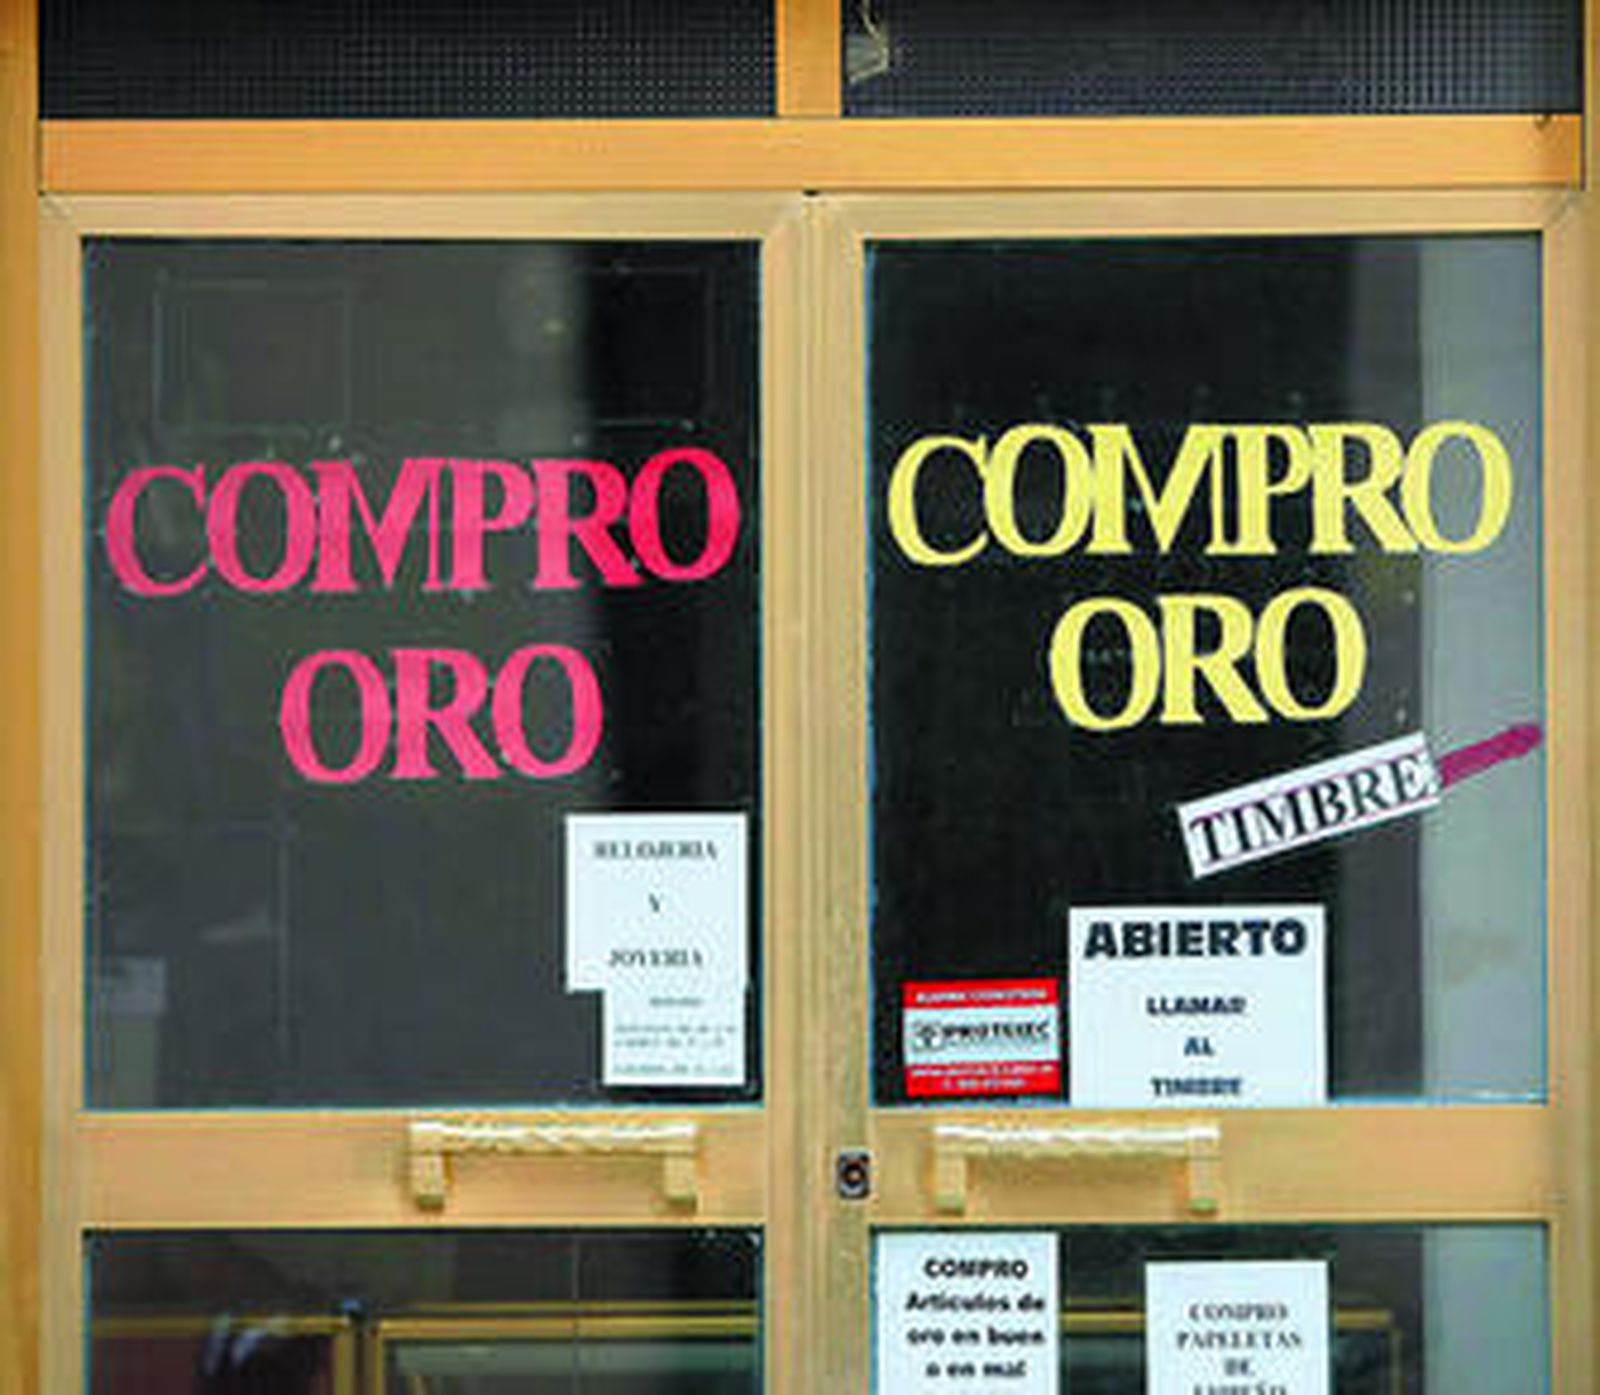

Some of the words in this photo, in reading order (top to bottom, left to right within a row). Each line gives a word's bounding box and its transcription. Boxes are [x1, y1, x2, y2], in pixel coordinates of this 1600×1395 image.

[888, 421, 1512, 566] COMPRO
[105, 447, 741, 595] COMPRO
[1049, 587, 1367, 731] ORO
[280, 644, 603, 783] ORO
[1189, 753, 1431, 866] TIMBRE
[1084, 918, 1308, 959] ABIERTO
[1146, 996, 1247, 1017] LLAMAR
[1184, 1037, 1216, 1057] AL
[923, 1257, 1029, 1280] COMPRO
[1017, 1291, 1046, 1312] de
[1188, 1302, 1289, 1322] COMPRO
[906, 1328, 945, 1346] oro
[952, 1329, 981, 1346] en
[987, 1325, 1046, 1346] buen
[947, 1362, 975, 1378] en
